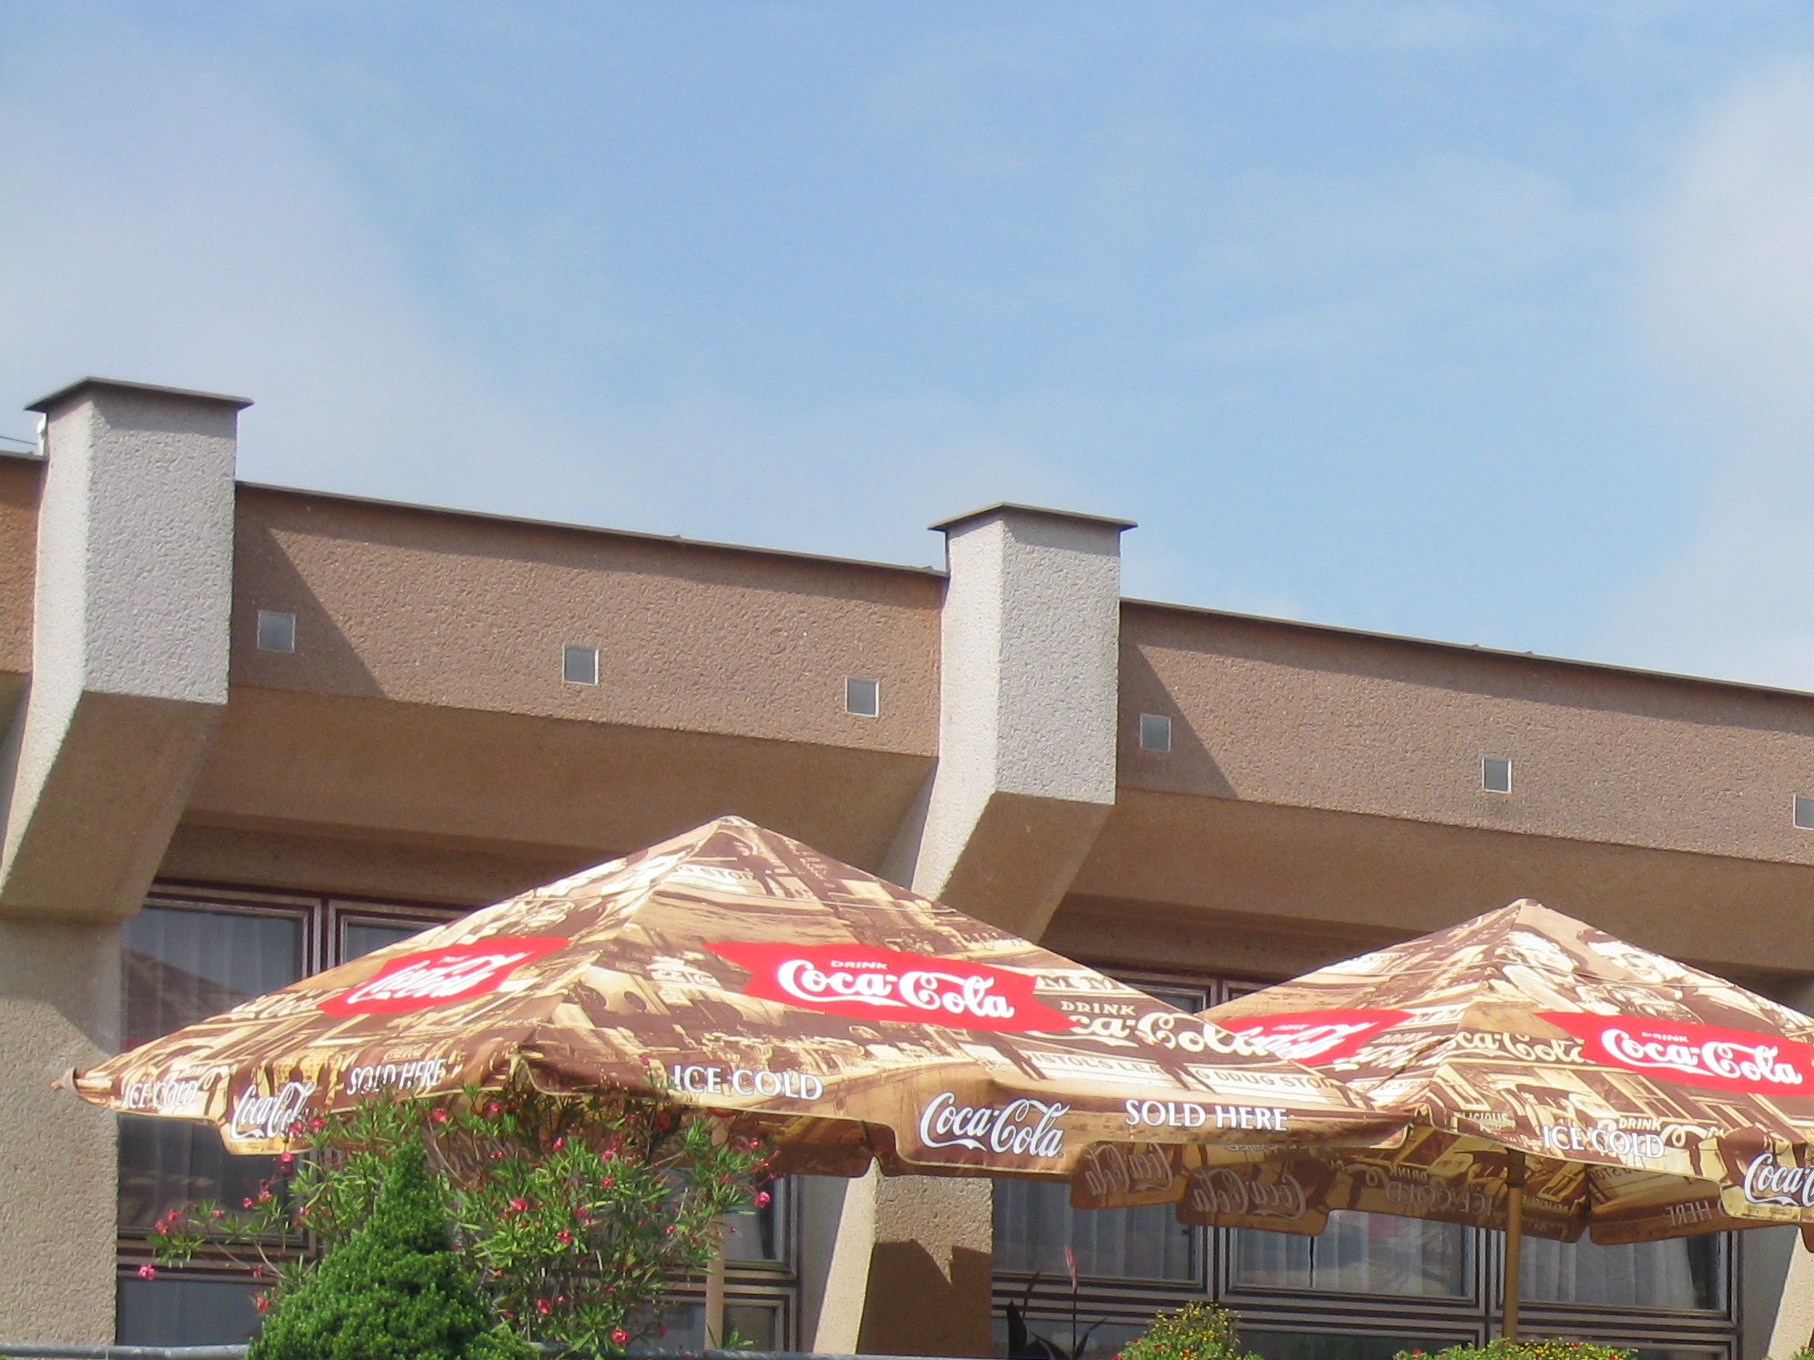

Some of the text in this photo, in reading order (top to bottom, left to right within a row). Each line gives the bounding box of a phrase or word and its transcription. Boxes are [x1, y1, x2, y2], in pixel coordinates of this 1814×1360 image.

[830, 958, 889, 971] DRINK
[777, 958, 1015, 1019] Coca-Cola
[1060, 1000, 1137, 1016] DRINK
[1601, 1028, 1803, 1084] Coca-Cola
[673, 1064, 824, 1101] ICE COLD
[919, 1091, 1071, 1159] Coca-Cola
[1124, 1099, 1289, 1133] SOLD HERE
[1618, 1117, 1662, 1131] DRINK
[1542, 1124, 1665, 1159] ICE COLD
